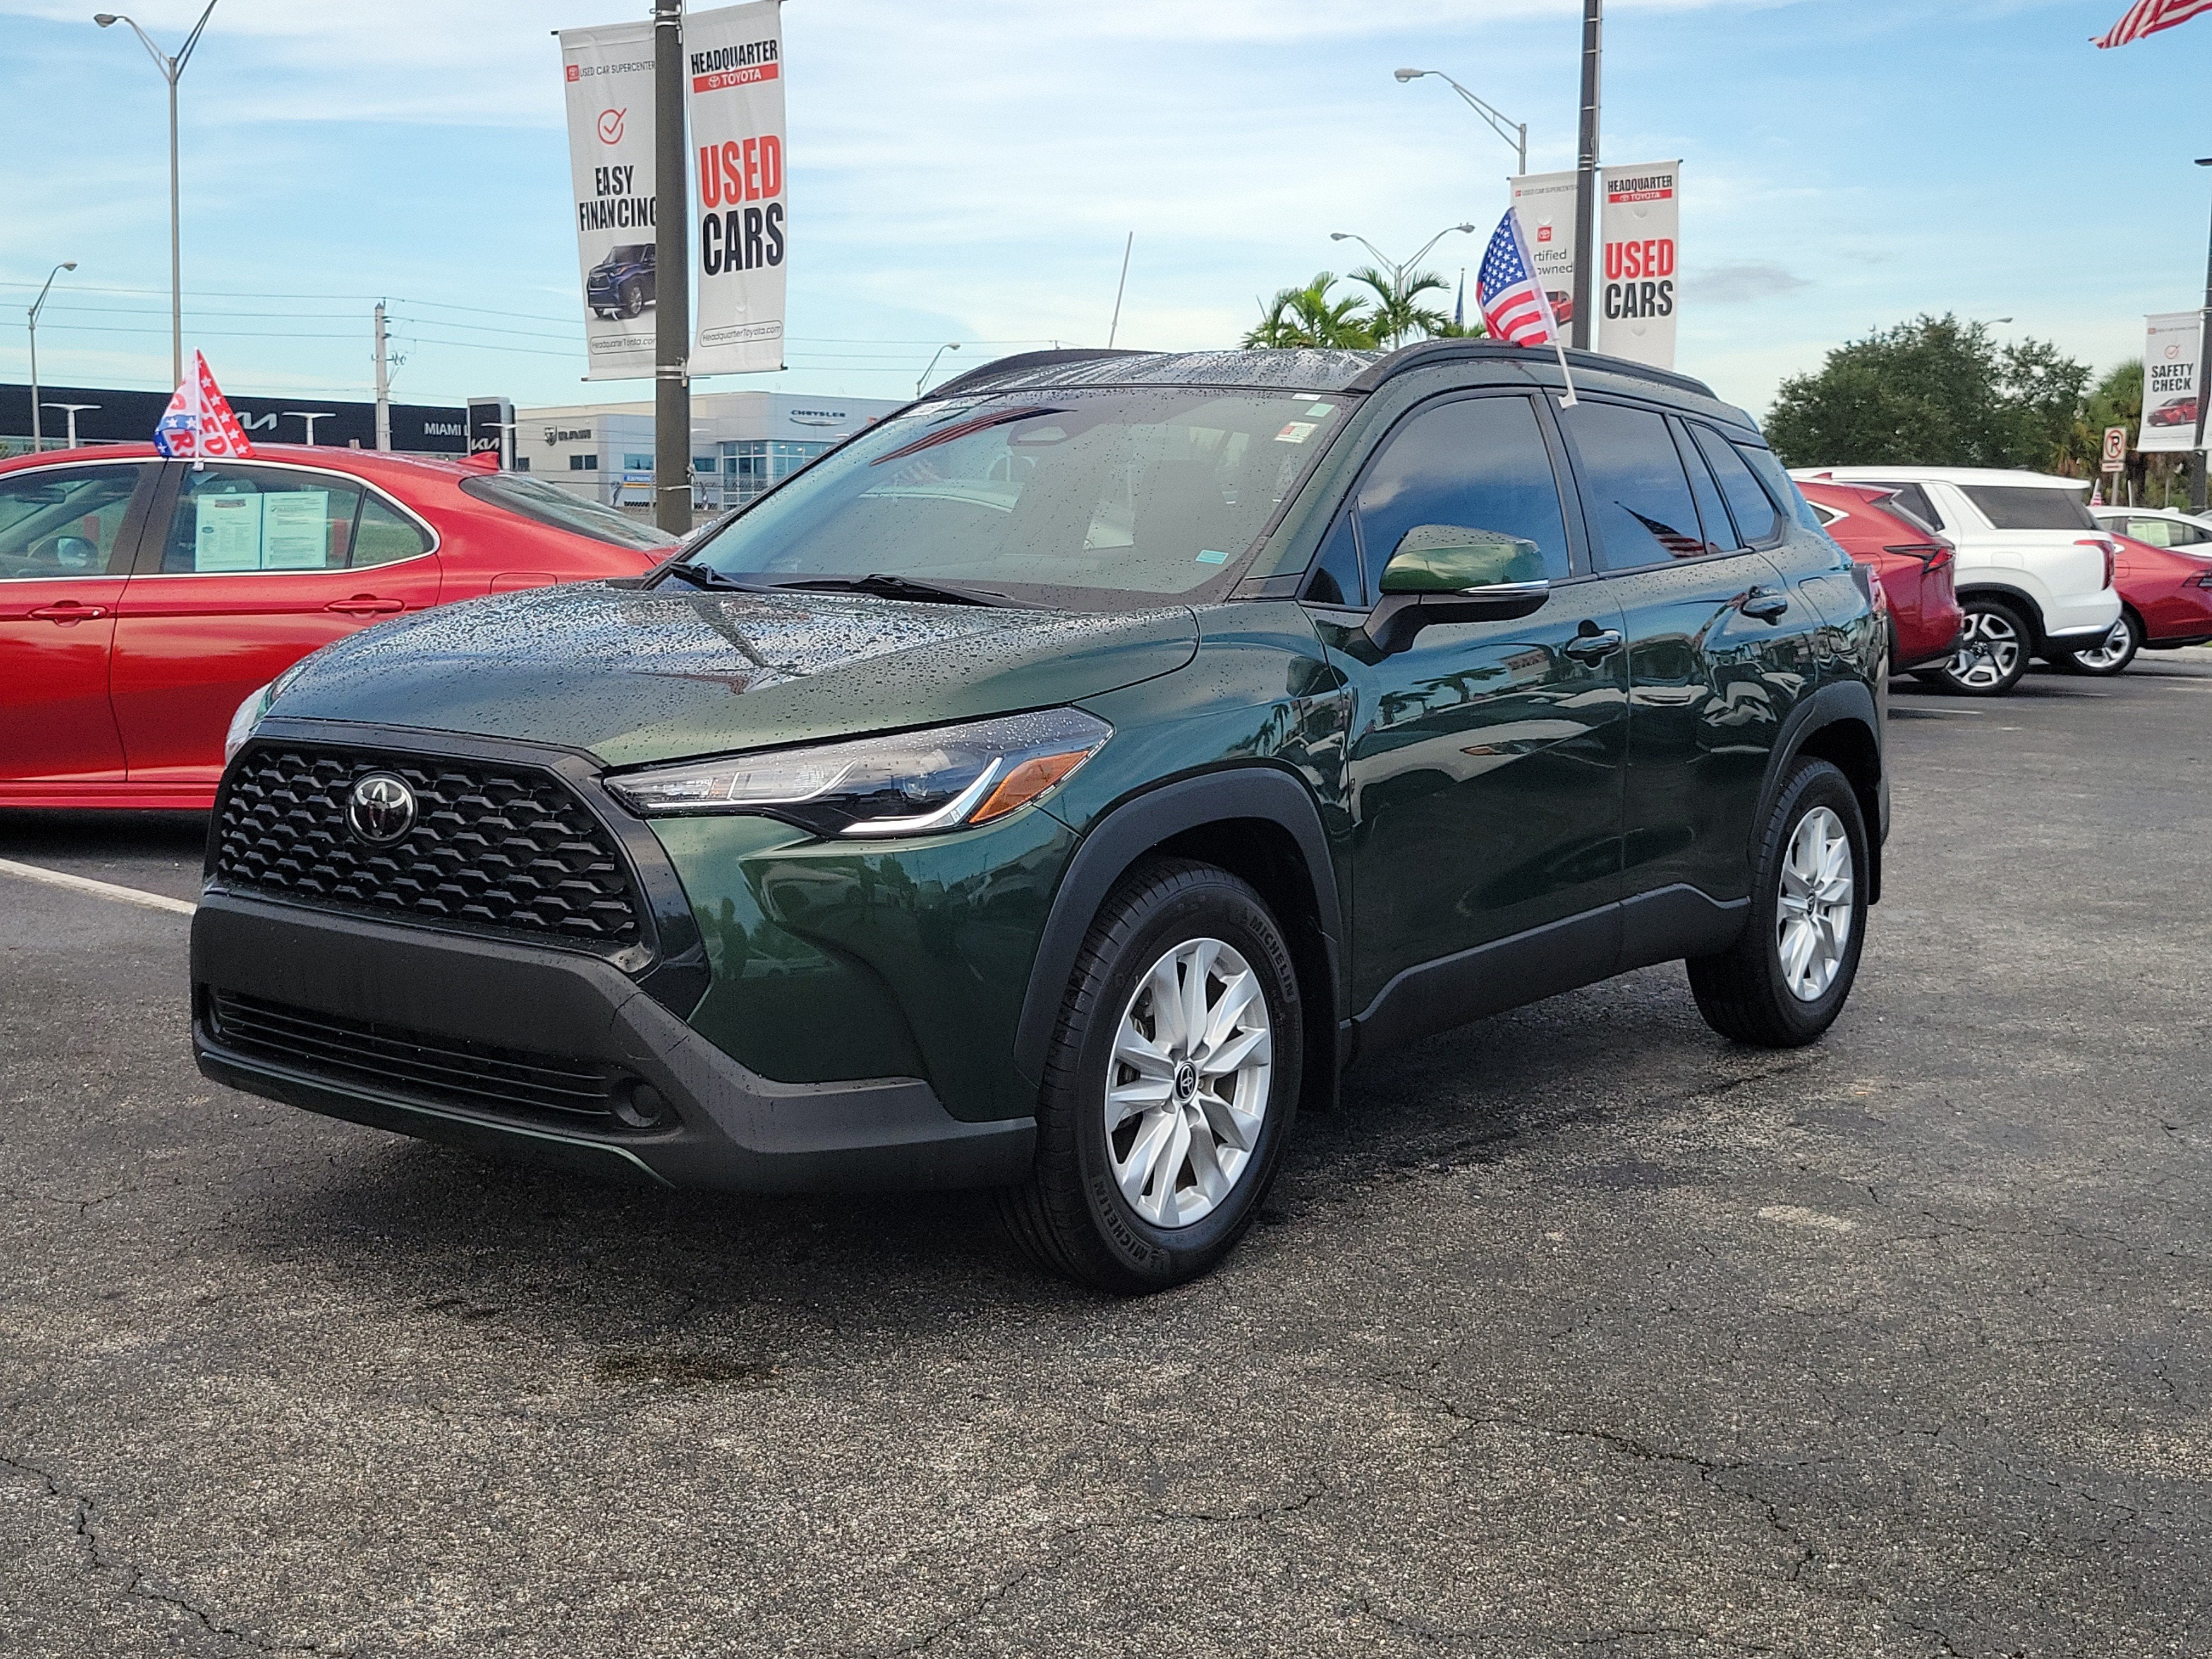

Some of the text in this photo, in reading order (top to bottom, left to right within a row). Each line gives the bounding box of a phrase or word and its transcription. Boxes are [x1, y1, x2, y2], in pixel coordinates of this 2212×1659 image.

[691, 40, 778, 75] HEADQUARTER
[580, 66, 595, 77] USED
[596, 65, 610, 75] CAR
[721, 69, 762, 86] TOYOTA
[699, 135, 781, 208] USED
[595, 165, 634, 196] EASY
[1608, 175, 1672, 192] HEADQUARTER
[1630, 191, 1660, 201] TOYOTA
[703, 202, 784, 276] CARS
[1534, 249, 1567, 261] rtified
[1605, 239, 1673, 280] USED
[1605, 280, 1673, 319] CARS
[2152, 363, 2193, 379] SAFETY
[2152, 377, 2191, 392] CHECK
[424, 422, 461, 436] MIAMI
[558, 429, 591, 441] RAM
[1249, 916, 1294, 997] MICHELIN
[1094, 1181, 1148, 1260] MICHELIN
